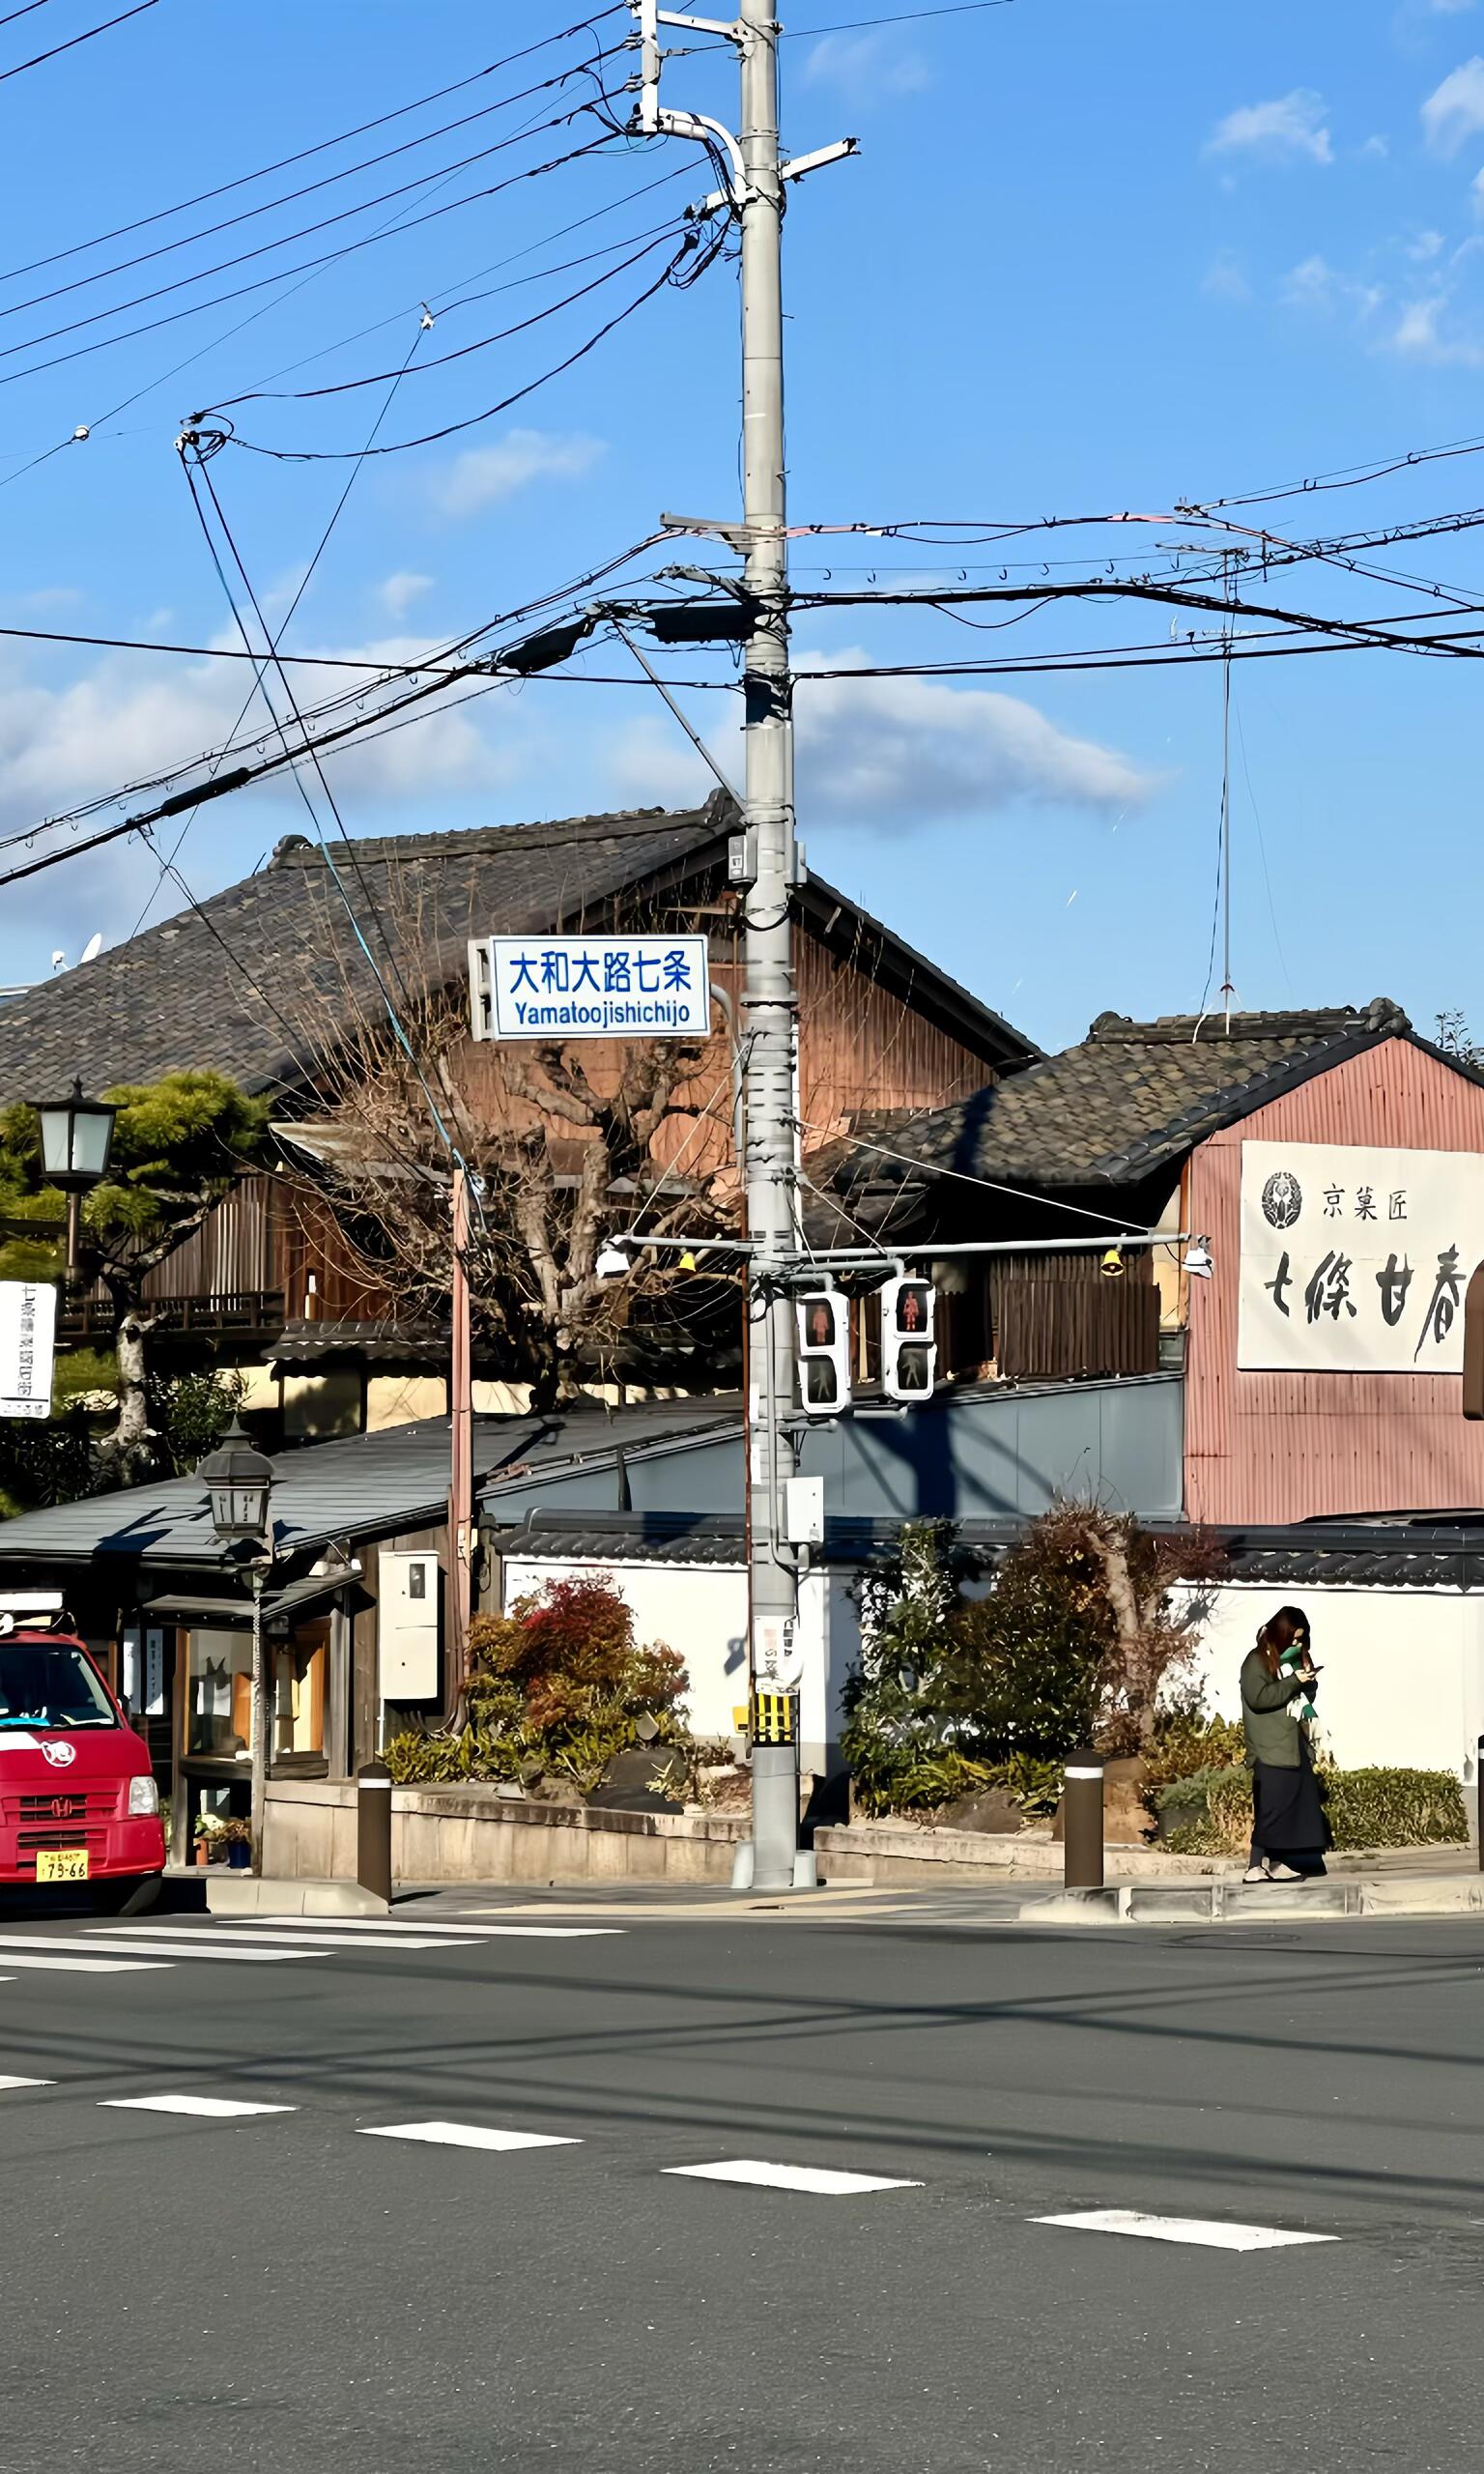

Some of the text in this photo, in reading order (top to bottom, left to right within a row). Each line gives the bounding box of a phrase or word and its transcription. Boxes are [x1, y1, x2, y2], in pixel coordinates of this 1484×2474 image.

[509, 950, 692, 993] 大和大路七条
[515, 1000, 691, 1029] Yamatoojishichijo
